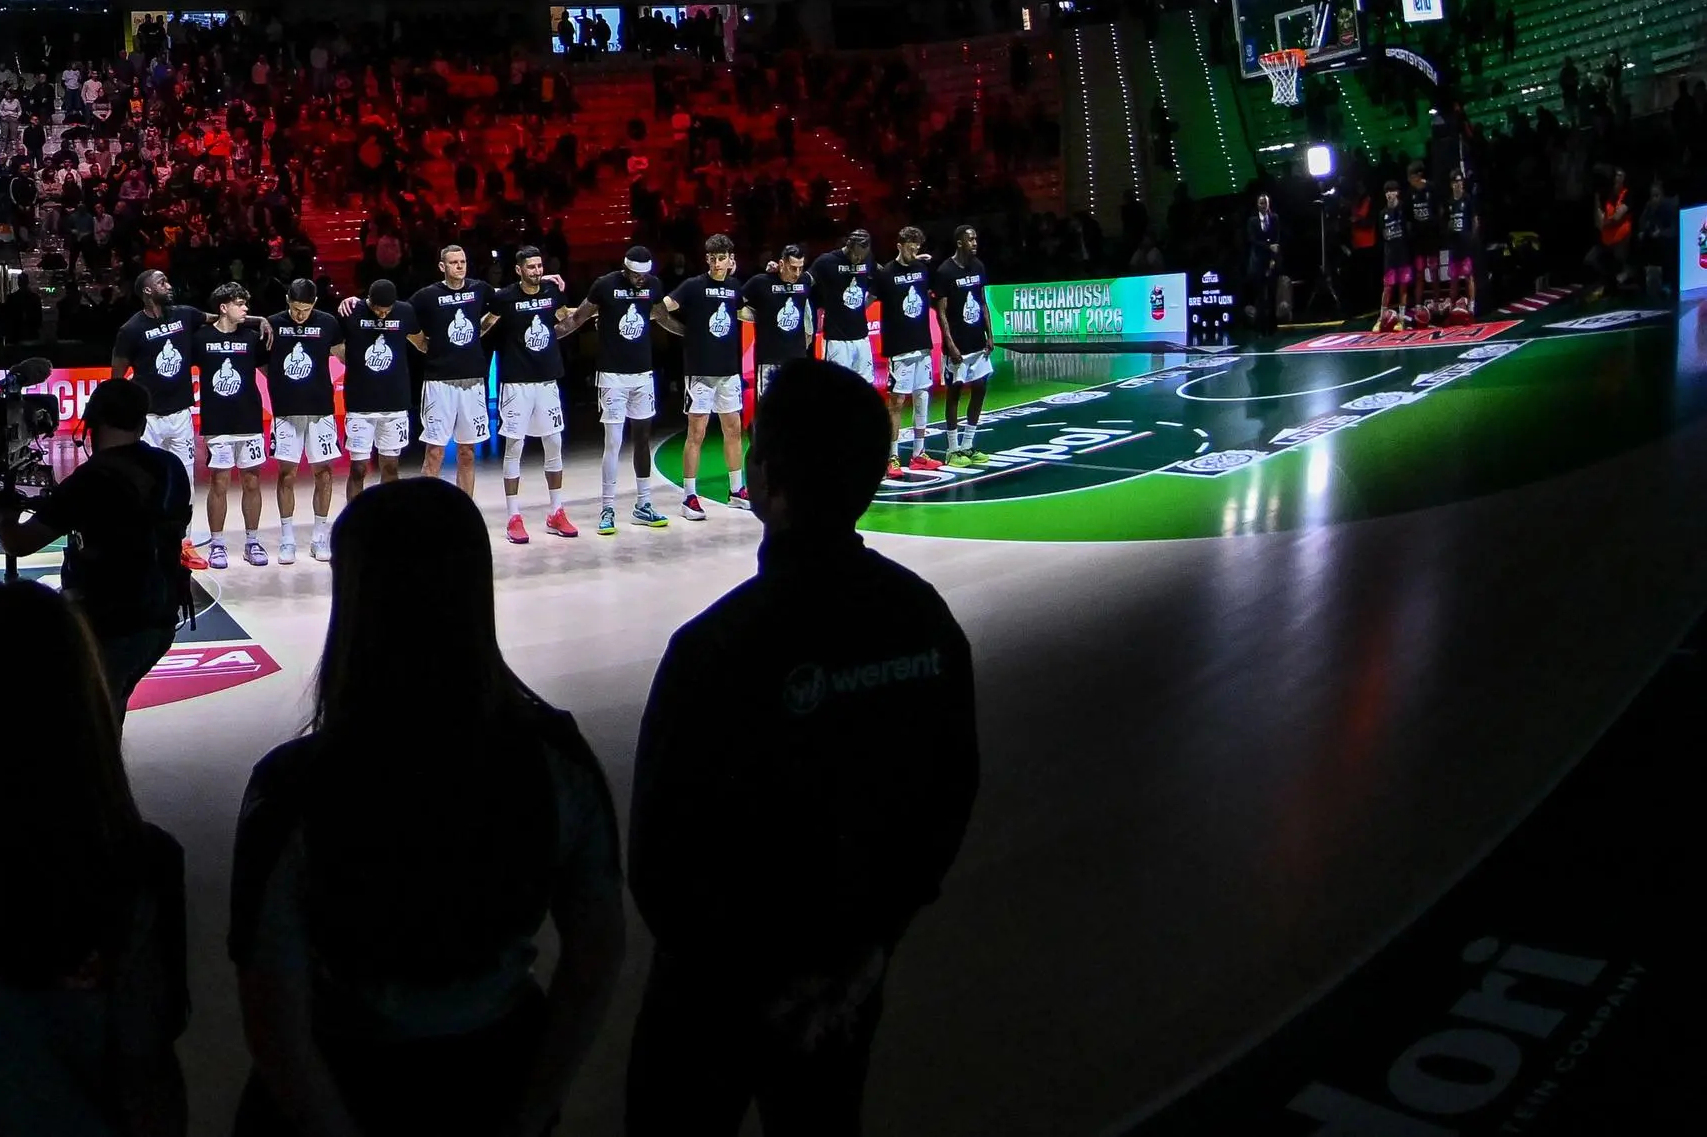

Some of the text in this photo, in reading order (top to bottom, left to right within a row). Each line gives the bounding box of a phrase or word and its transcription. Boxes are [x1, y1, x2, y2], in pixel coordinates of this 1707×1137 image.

[1013, 284, 1112, 310] FRECCIAROSSA
[360, 319, 376, 327] FINAL
[1003, 311, 1039, 333] FINAL
[1044, 310, 1081, 333] EIGHT
[1086, 308, 1124, 333] 2026
[279, 327, 295, 335] FINAL
[206, 343, 223, 351] FINAL
[476, 423, 486, 437] 22
[249, 446, 261, 460] 33
[321, 443, 332, 455] 31
[831, 647, 943, 693] werent
